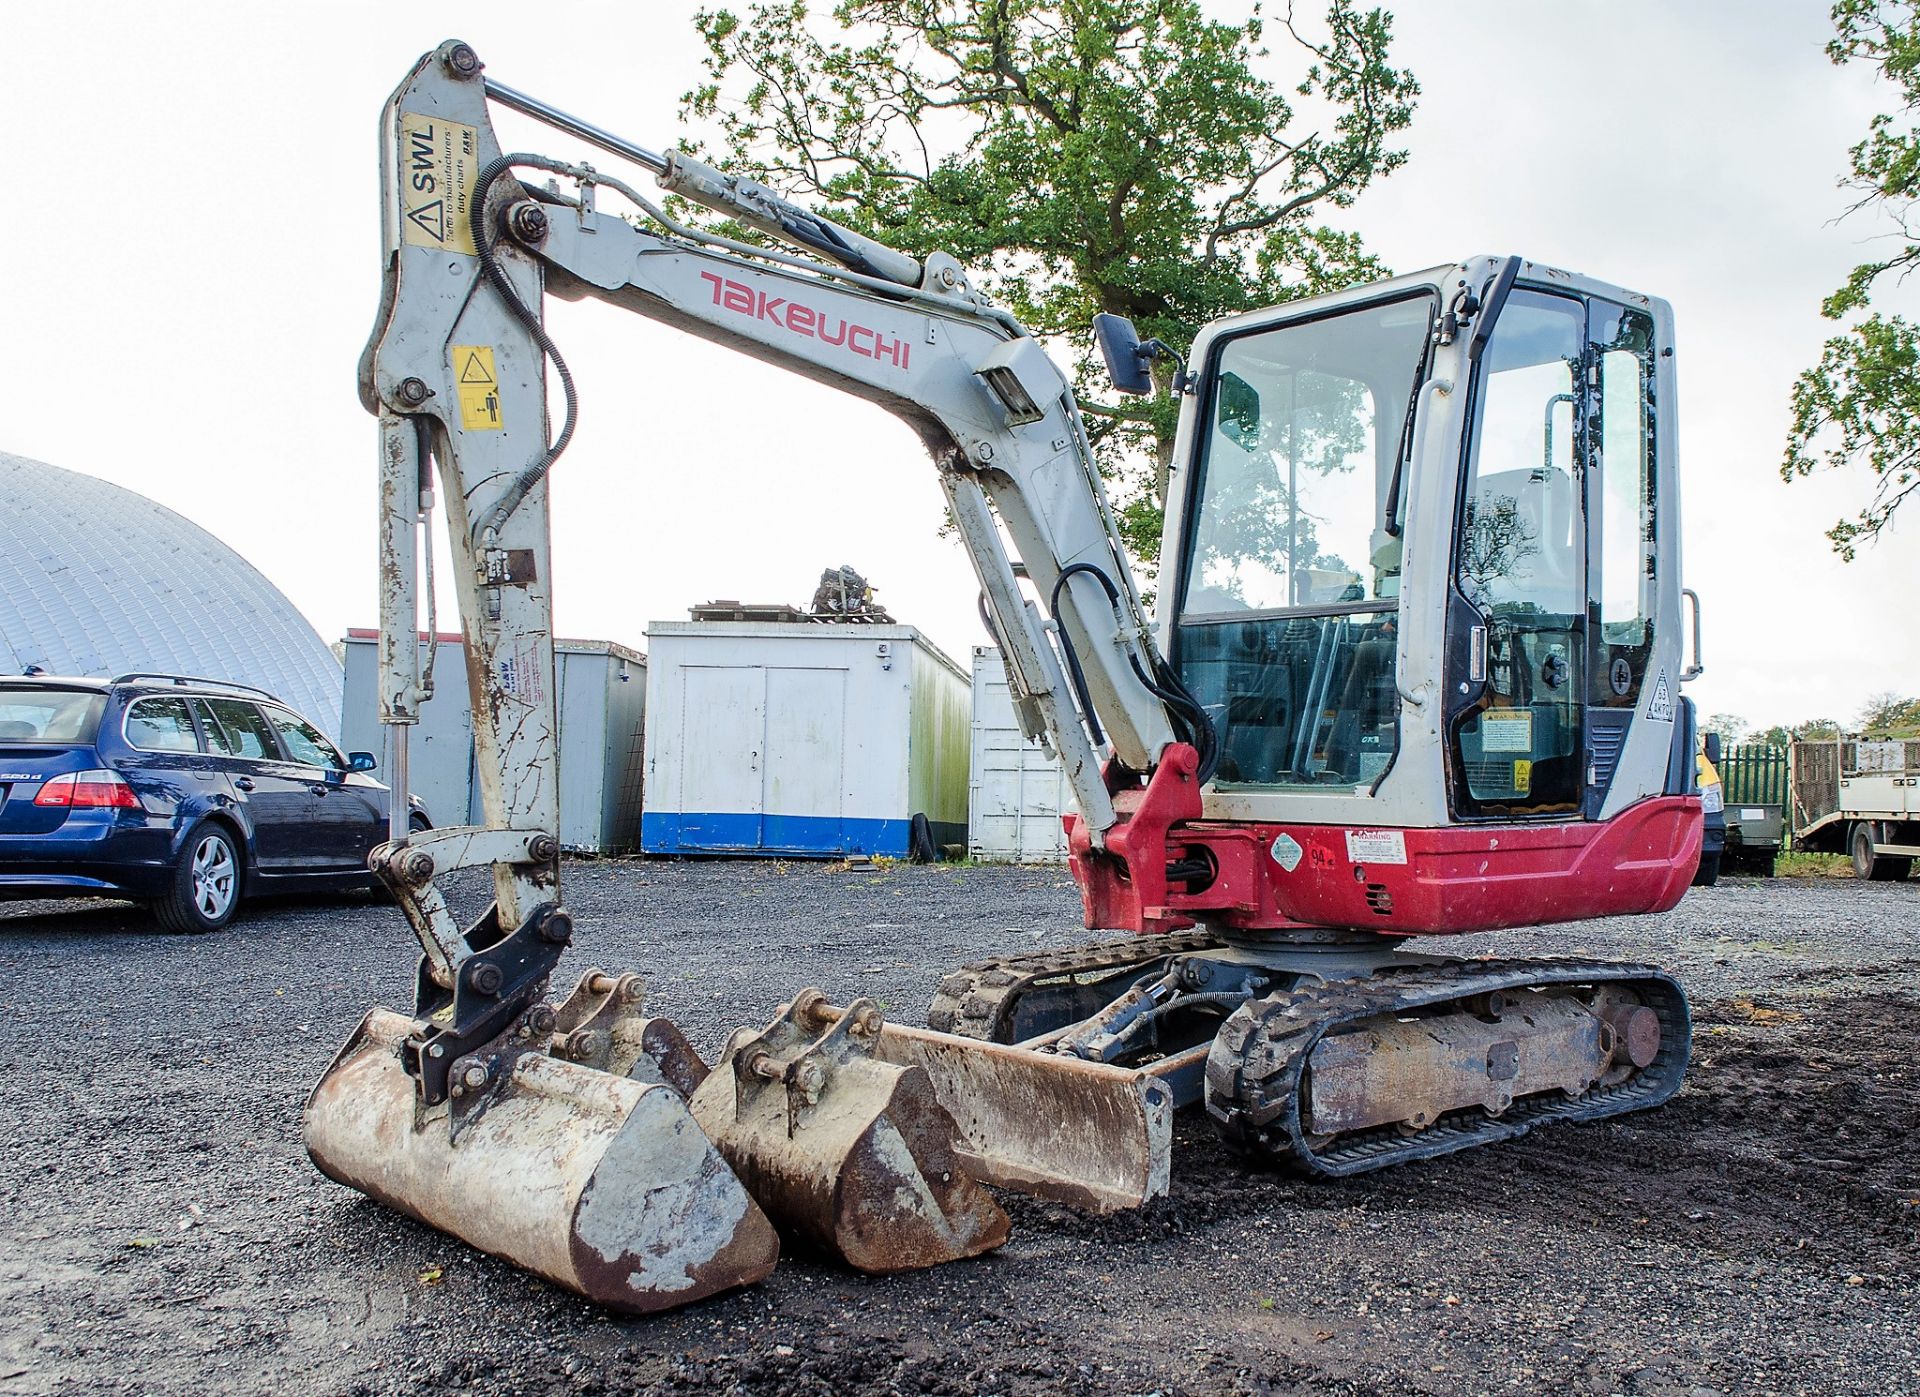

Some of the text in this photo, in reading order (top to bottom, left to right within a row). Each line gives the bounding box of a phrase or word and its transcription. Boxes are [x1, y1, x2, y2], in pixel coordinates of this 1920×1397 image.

[411, 125, 436, 193] SWL
[456, 159, 467, 214] duty charts
[446, 203, 454, 214] to
[700, 270, 910, 370] TAKEUCHI
[1358, 832, 1392, 841] WARNING
